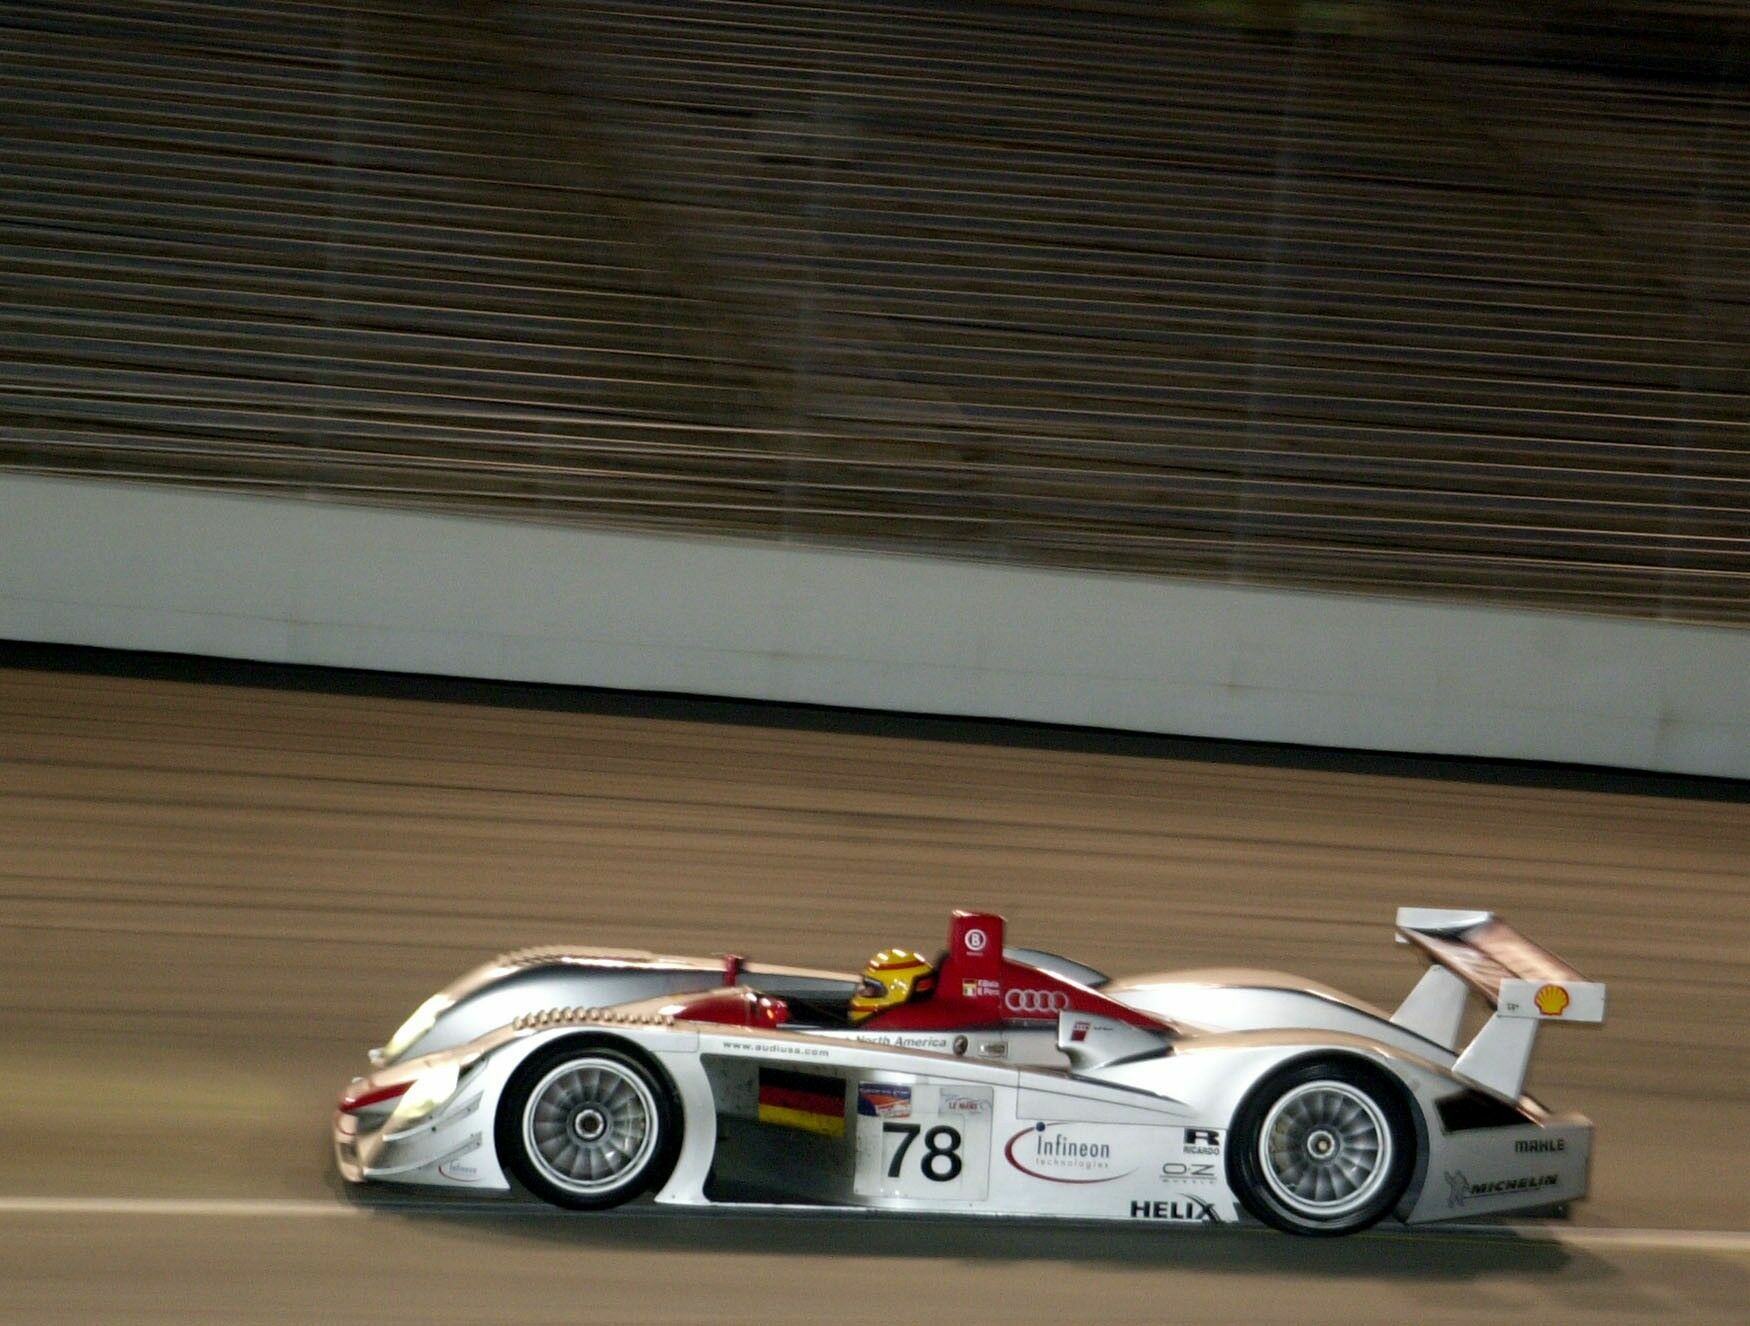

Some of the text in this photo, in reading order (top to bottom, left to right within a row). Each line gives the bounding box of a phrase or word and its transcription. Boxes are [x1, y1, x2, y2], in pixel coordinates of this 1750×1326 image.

[722, 1041, 829, 1056] www.audiusa.com
[895, 1037, 946, 1047] America
[883, 1121, 962, 1182] 78
[1037, 1133, 1110, 1158] Infineon
[1183, 1146, 1220, 1155] RICARDO
[1515, 1139, 1565, 1153] MAHLE
[1036, 1158, 1109, 1169] technologies
[1471, 1174, 1558, 1194] MICHELIN
[1130, 1200, 1220, 1221] HELIX
